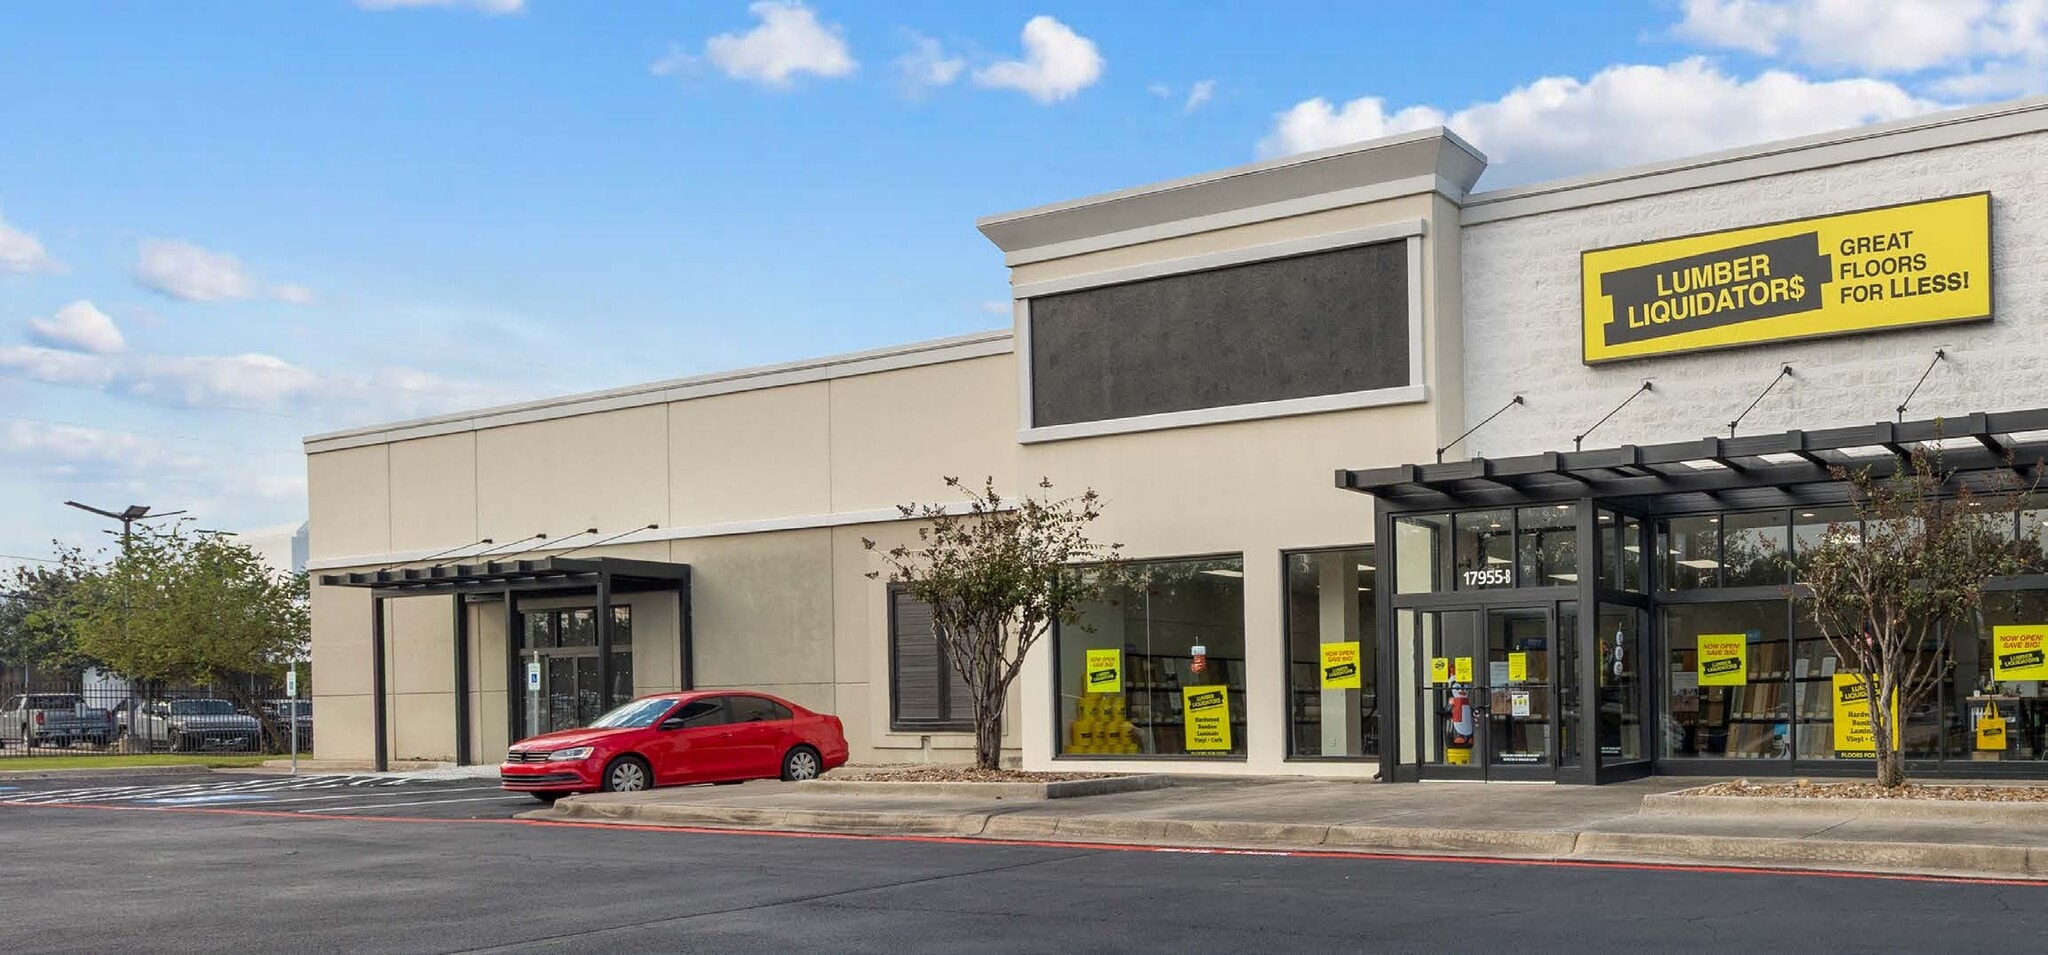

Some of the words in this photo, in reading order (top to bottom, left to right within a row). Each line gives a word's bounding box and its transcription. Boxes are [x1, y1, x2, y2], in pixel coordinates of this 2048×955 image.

[1840, 231, 1913, 256] GREAT
[1656, 253, 1770, 297] LUMBER
[1840, 253, 1927, 280] FLOORS
[1840, 283, 1884, 304] FOR
[1890, 271, 1969, 298] LLESS!
[1628, 274, 1806, 329] LIQUIDATOR$
[1463, 569, 1511, 585] 17955-B
[2010, 652, 2033, 661] LUMBER
[1846, 735, 1864, 743] Vinyl
